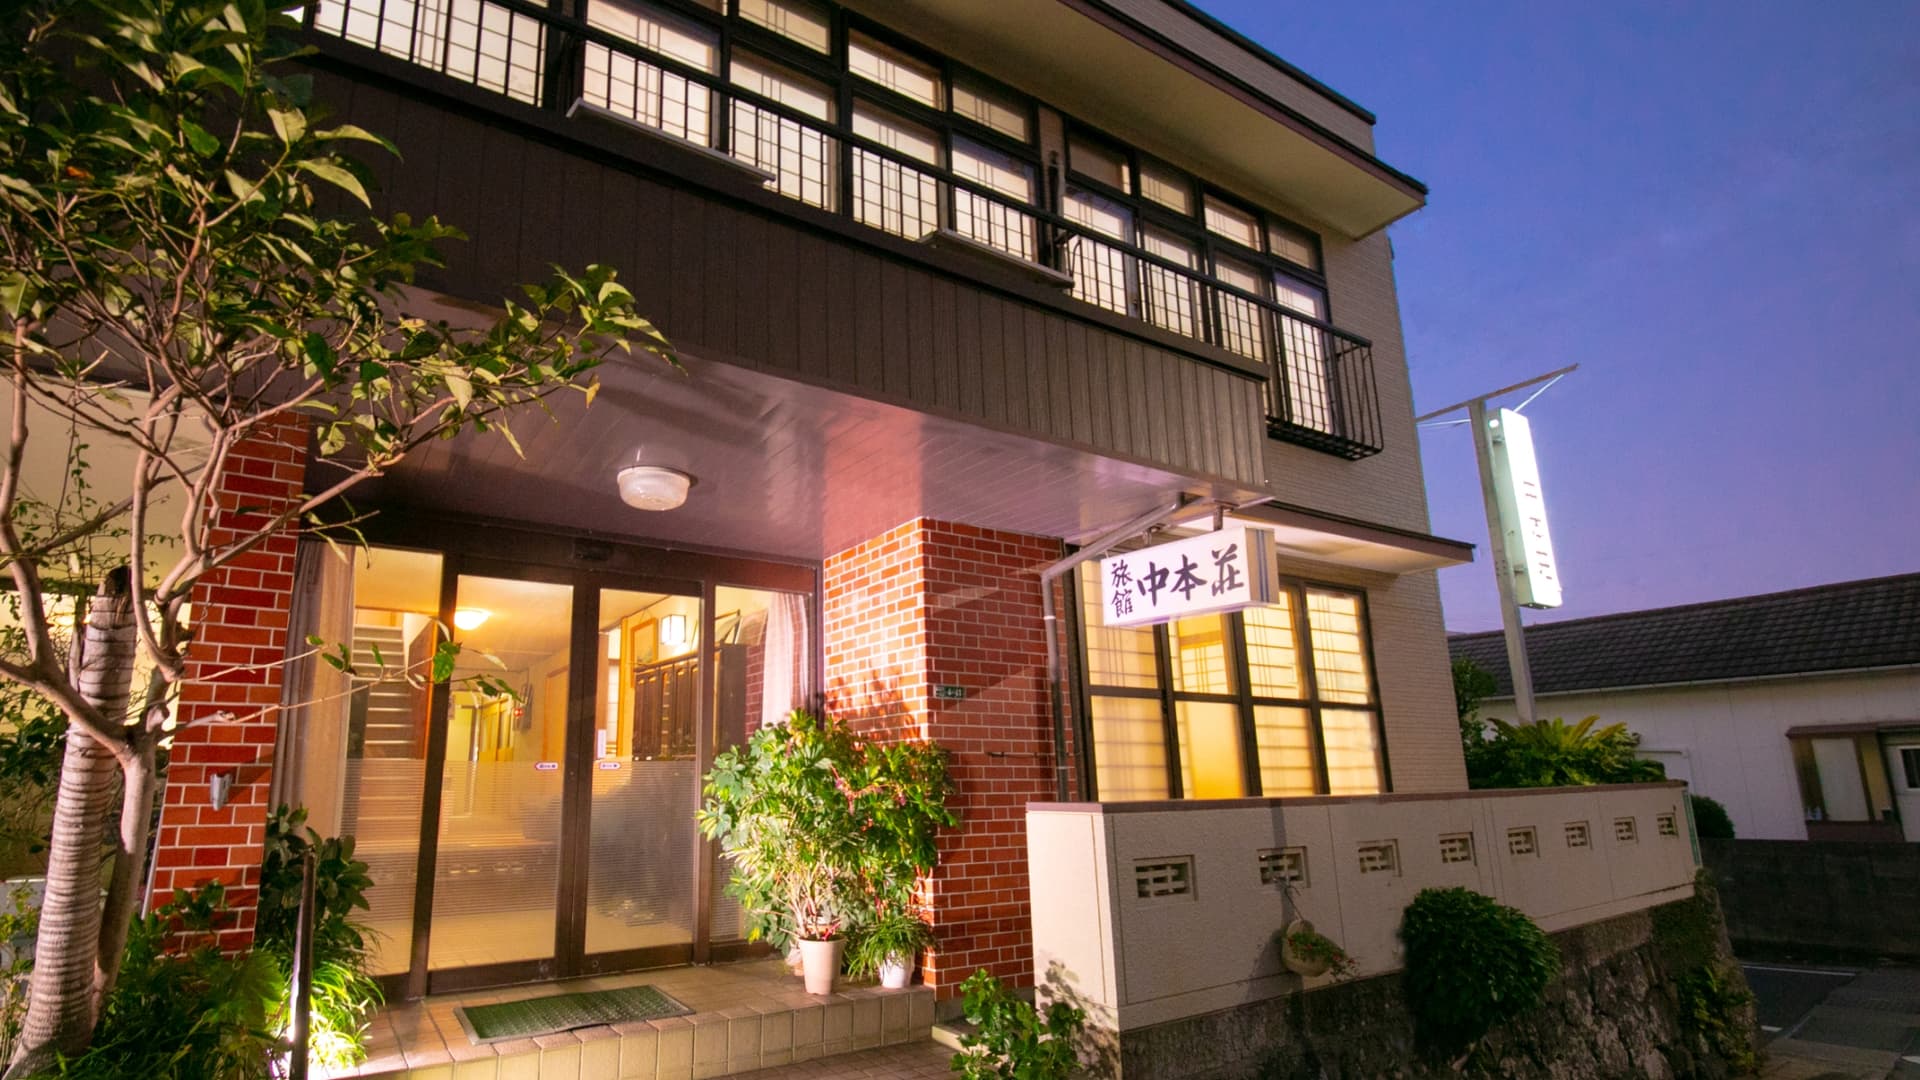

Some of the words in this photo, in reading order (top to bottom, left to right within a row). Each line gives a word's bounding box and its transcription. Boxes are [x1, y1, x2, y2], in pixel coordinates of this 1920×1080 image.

[1111, 559, 1134, 618] 旅館
[1136, 543, 1244, 607] 中本荘
